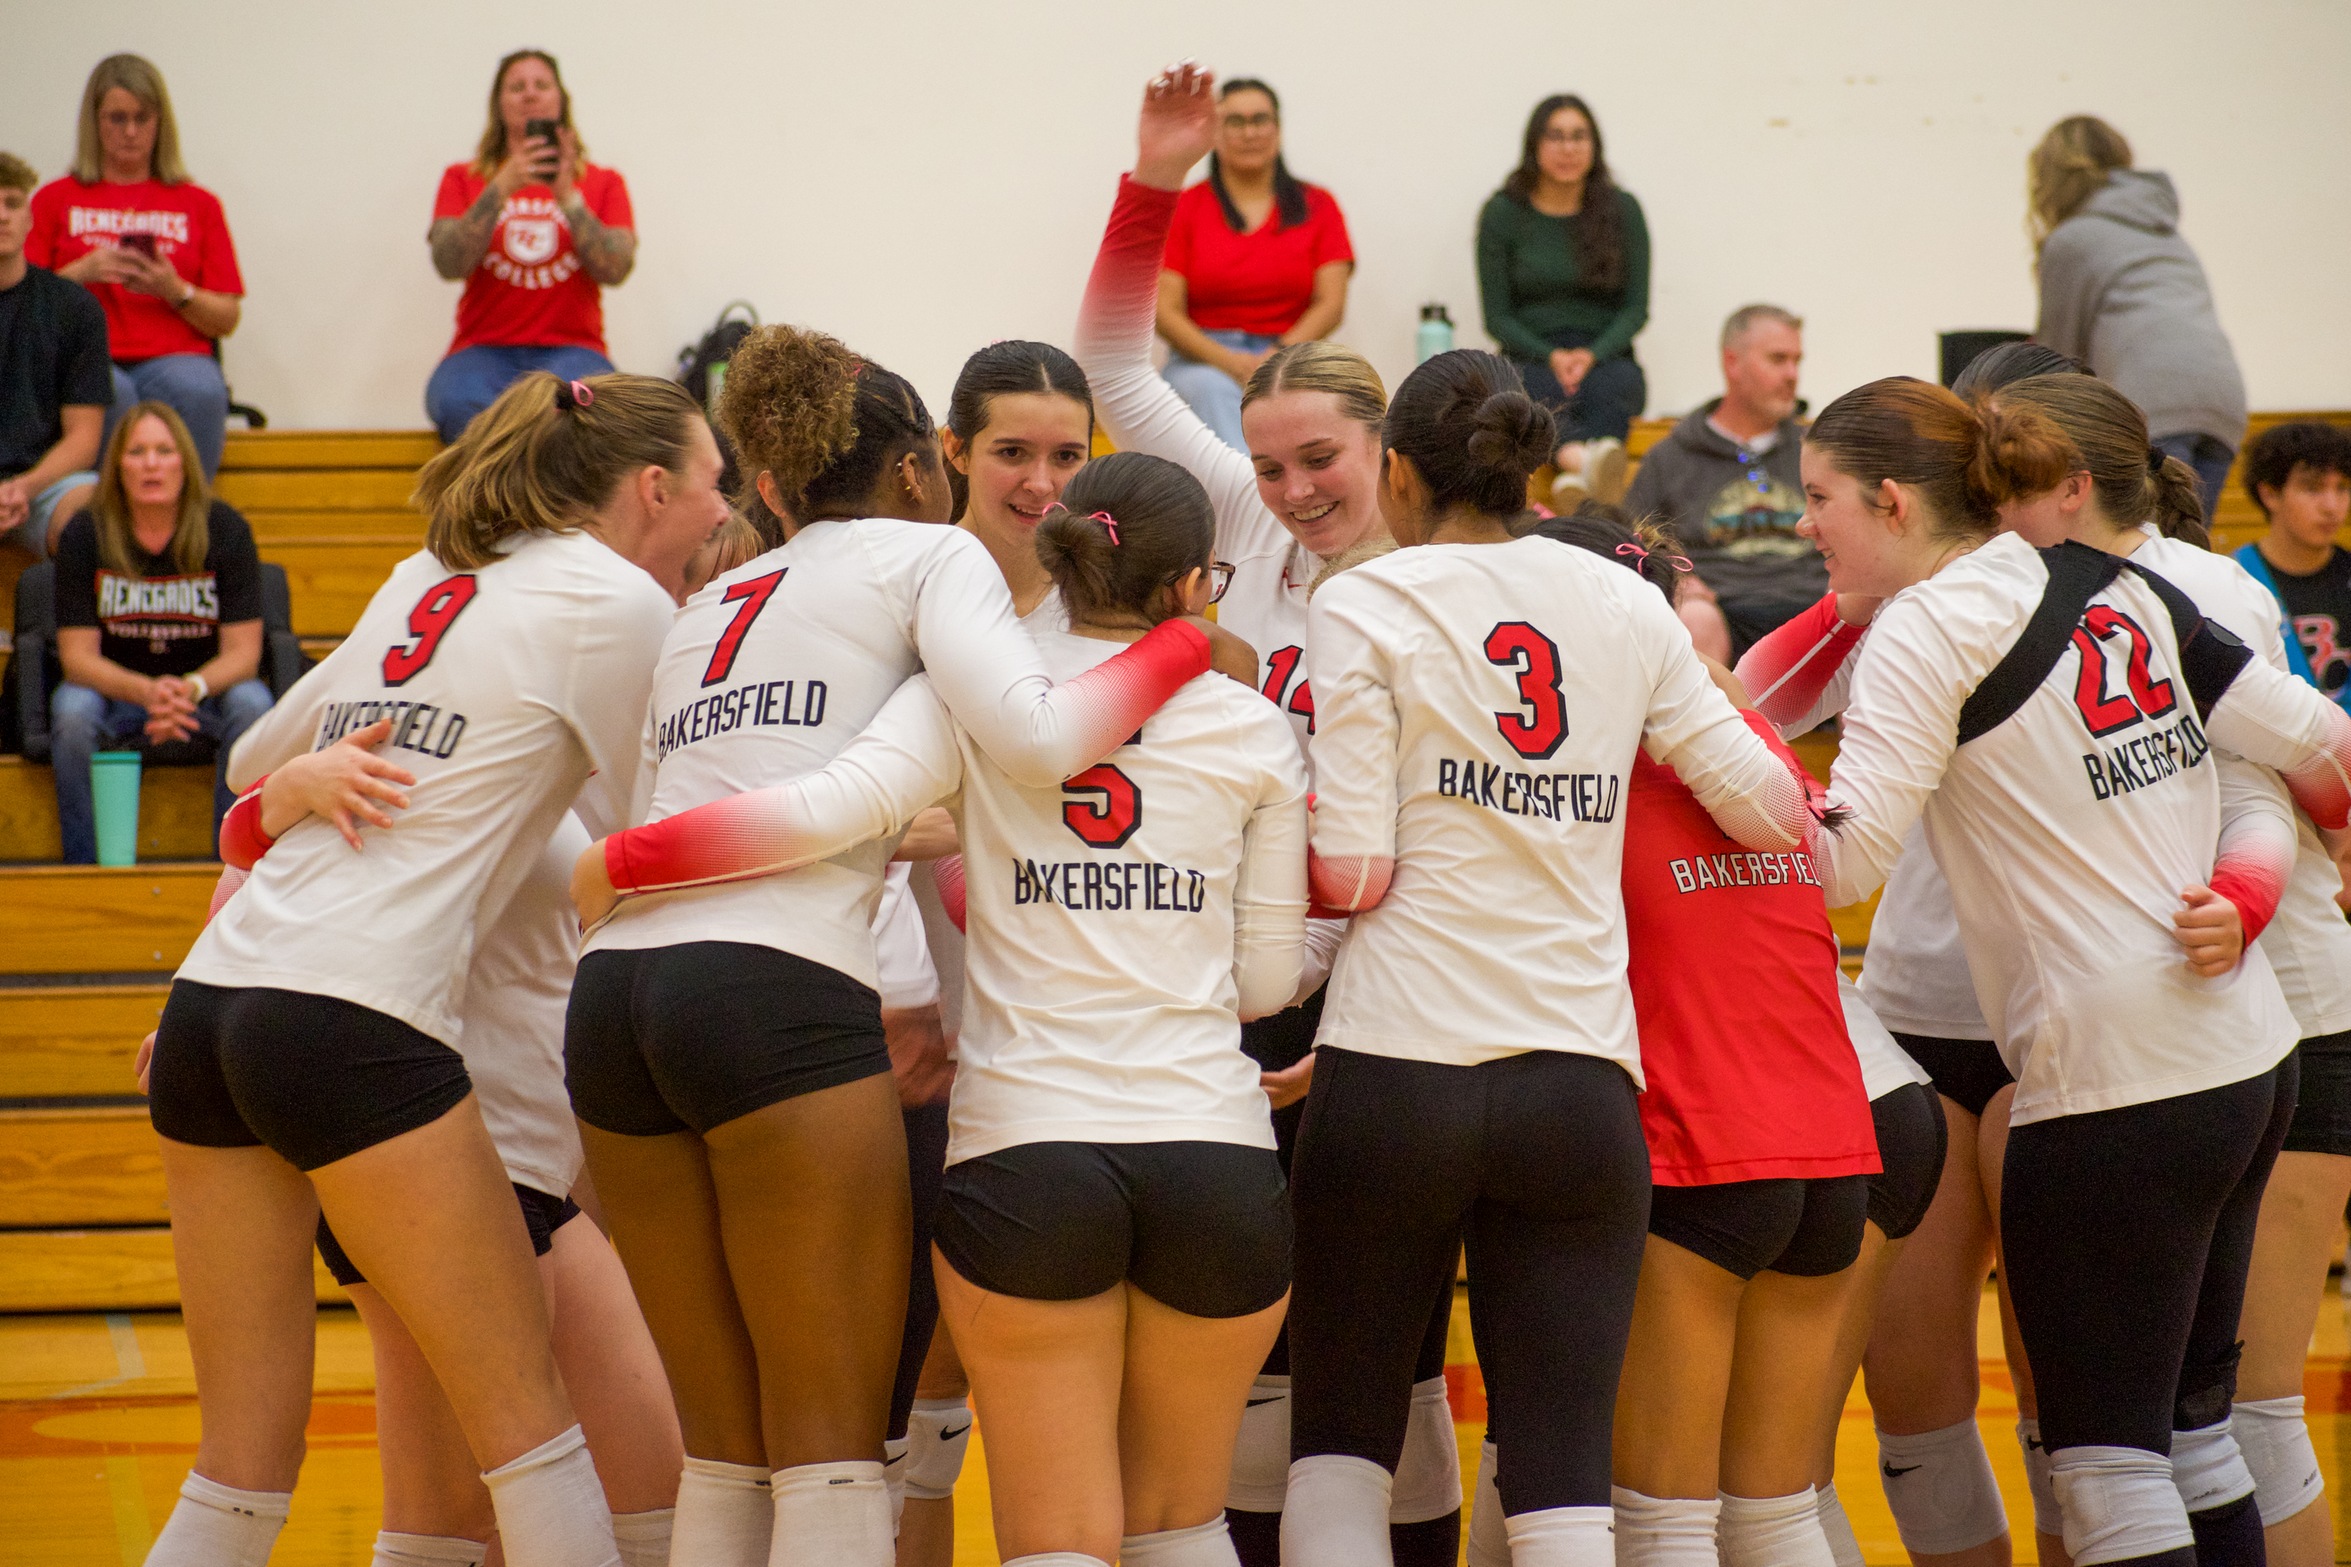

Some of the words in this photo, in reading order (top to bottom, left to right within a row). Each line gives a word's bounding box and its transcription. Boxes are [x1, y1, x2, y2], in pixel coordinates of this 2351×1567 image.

[69, 205, 189, 244] RENEGADES
[98, 574, 220, 620] RENEGADES
[382, 574, 477, 688] 9
[701, 567, 789, 689] 7
[1483, 621, 1570, 761] 3
[2071, 604, 2177, 740] 22
[658, 680, 828, 764] BAKERSFIELD
[2082, 714, 2209, 801] BAKERSFILD
[1062, 728, 1142, 849] 5
[1438, 758, 1619, 823] BAKERSFIELD
[1012, 858, 1206, 913] BAKERSFIELD
[1668, 852, 1823, 894] BAKERSFIEL
